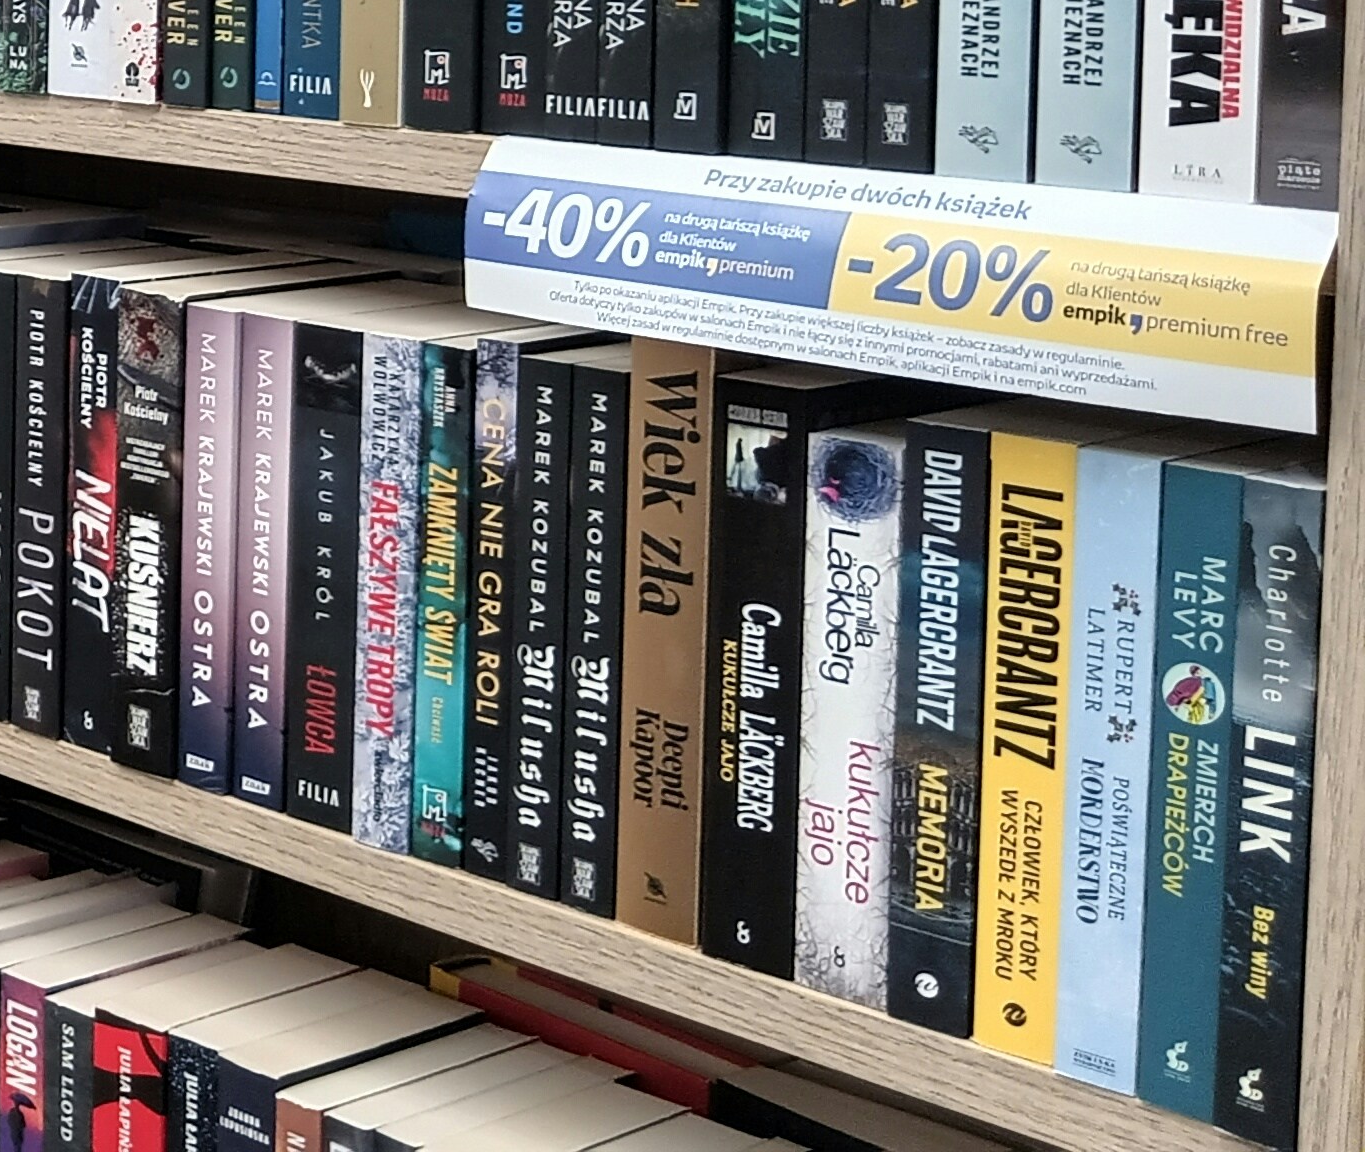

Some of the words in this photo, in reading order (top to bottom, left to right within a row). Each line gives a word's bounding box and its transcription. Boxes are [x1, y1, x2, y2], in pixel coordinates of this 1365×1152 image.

[289, 73, 332, 95] FILIA
[483, 189, 651, 268] -40%
[665, 212, 679, 224] na
[682, 213, 718, 231] drugą
[719, 218, 759, 236] tańszą
[761, 222, 811, 242] książkę
[704, 169, 756, 193] Przy
[760, 175, 846, 206] zakupie
[851, 185, 930, 209] dwóch
[935, 188, 1031, 221] książek
[660, 232, 678, 245] dla
[679, 234, 736, 252] Klientów
[848, 233, 1053, 323] -20%
[1071, 261, 1090, 274] na
[1092, 262, 1135, 282] drugą
[1138, 268, 1188, 290] tańszą
[1191, 272, 1250, 296] książkę
[574, 280, 597, 294] Tylko
[613, 285, 656, 302] okazaniu
[657, 291, 700, 310] aplikacji
[739, 305, 763, 320] Przy
[765, 308, 805, 325] zakupie
[807, 313, 855, 333] większej
[856, 319, 889, 337] liczby
[891, 325, 933, 343] książek
[945, 336, 987, 351] zobacz
[989, 343, 1030, 359] zasady
[1046, 350, 1125, 371] regulaminie.
[1066, 282, 1088, 298] dla
[1091, 284, 1162, 307] Klientów
[1147, 315, 1241, 341] premium
[1245, 323, 1288, 347] free
[201, 333, 215, 424] MAREK
[481, 397, 503, 490] CENA
[641, 373, 697, 512] Wiek
[197, 436, 215, 577] KRAJEWSKI
[479, 501, 503, 557] NIE
[17, 508, 54, 669] POKOT
[369, 481, 399, 636] FAŁSZYWE
[479, 569, 504, 636] GRA
[192, 588, 212, 710] OSTRA
[818, 527, 860, 687] Läckberg
[994, 484, 1064, 770] LAGERCRANTZ
[1173, 570, 1196, 648] LEVY
[1197, 557, 1227, 654] MARC
[1263, 544, 1296, 704] Charlotte
[366, 645, 396, 740] TROPY
[477, 650, 501, 726] ROLI
[805, 799, 835, 867] jajo
[846, 740, 880, 906] kukułcze
[914, 763, 948, 912] MEMORIA
[1162, 732, 1188, 895] DRAPIEŻCÓW
[1193, 739, 1218, 863] ZMIERZCH
[1239, 728, 1299, 863] LINK
[1249, 906, 1275, 940] Bez
[1245, 946, 1269, 998] winy
[5, 999, 38, 1096] LOGAN
[61, 1023, 74, 1070] SAM
[60, 1075, 74, 1141] LLOYD
